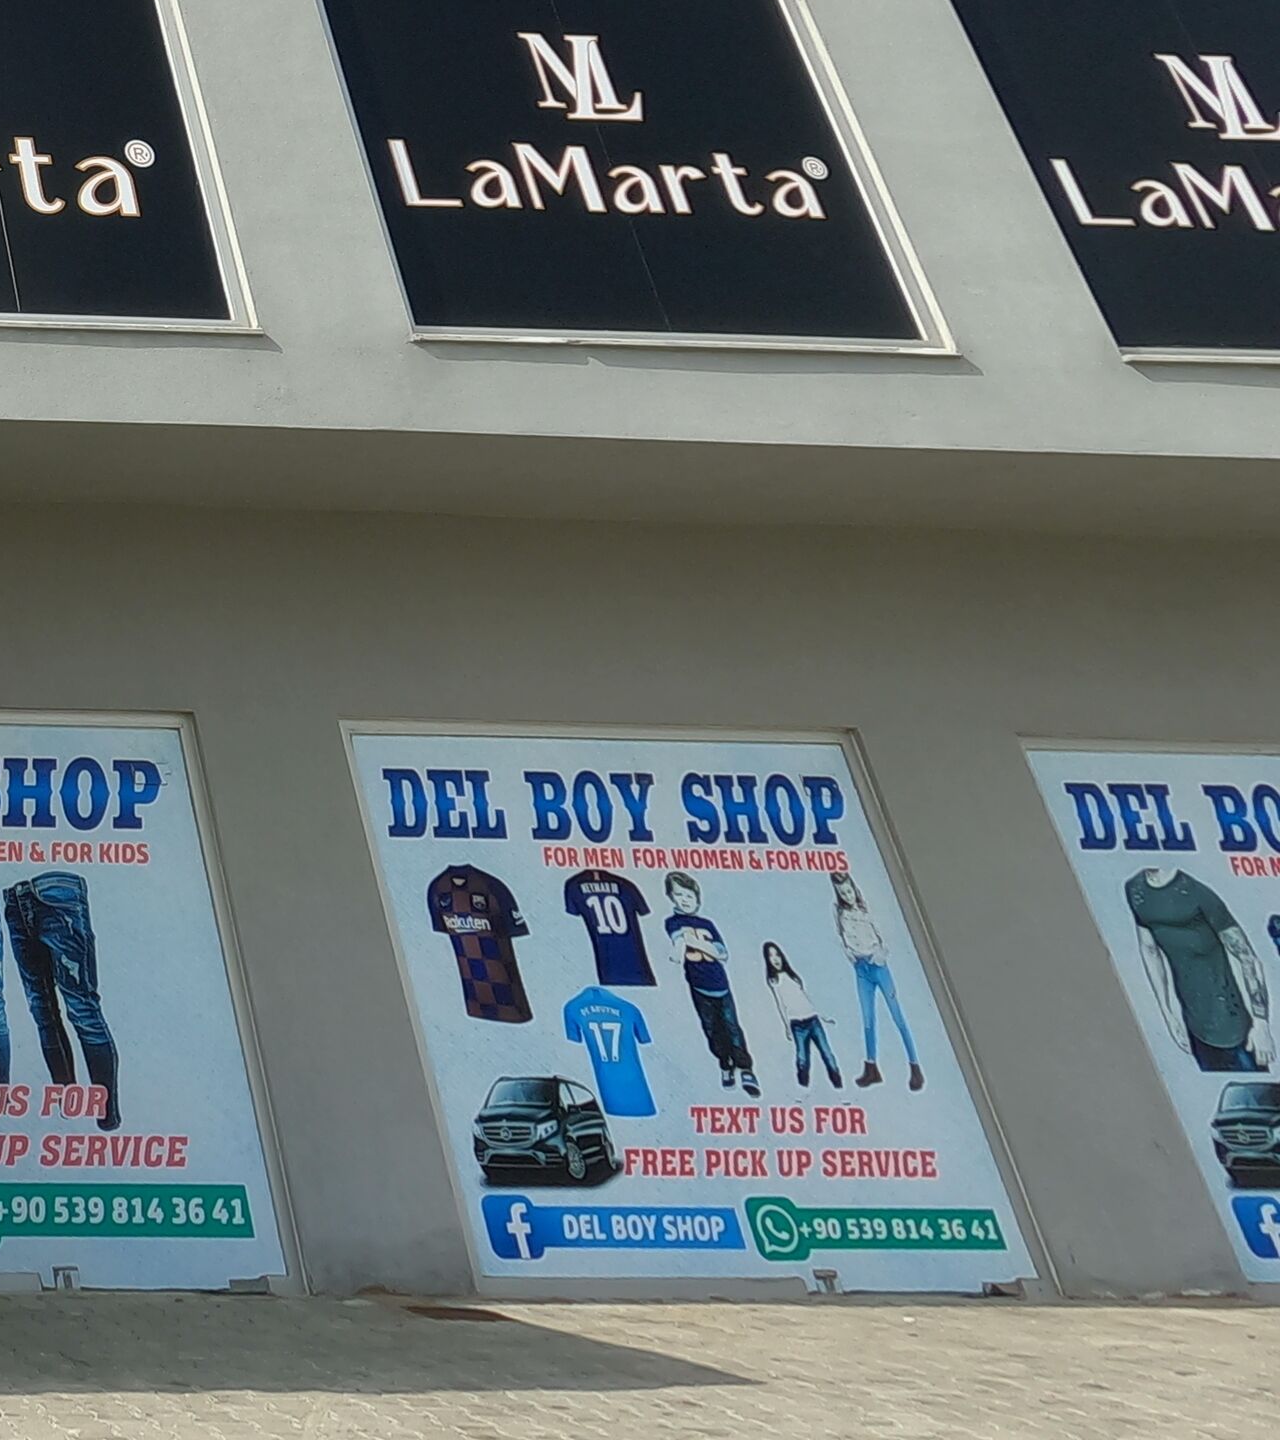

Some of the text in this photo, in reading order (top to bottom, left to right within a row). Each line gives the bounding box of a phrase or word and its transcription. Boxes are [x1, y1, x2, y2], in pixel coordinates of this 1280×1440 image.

[1048, 158, 1280, 232] LaM
[382, 768, 844, 846] DEL BOY SHOP
[1064, 782, 1280, 854] DEL BO
[29, 841, 46, 863] &
[51, 842, 90, 863] FOR
[99, 843, 150, 864] KIDS
[543, 847, 849, 872] FOR MEN FOR WOMEN & FOR KIDS
[1230, 856, 1267, 876] FOR
[442, 914, 491, 931] Rakuten
[586, 895, 628, 934] 10
[588, 1022, 621, 1062] 17
[40, 1085, 108, 1118] FOR
[690, 1107, 868, 1135] TEXT US FOR
[40, 1135, 188, 1168] SERVICE
[624, 1149, 937, 1178] FREE PICK UP SERVICE
[54, 1196, 104, 1224] 539
[112, 1197, 164, 1225] 814
[171, 1197, 205, 1225] 36
[212, 1197, 245, 1225] 41
[562, 1213, 726, 1242] DEL BOY SHOP
[799, 1217, 998, 1241] +90 539 814 36 41
